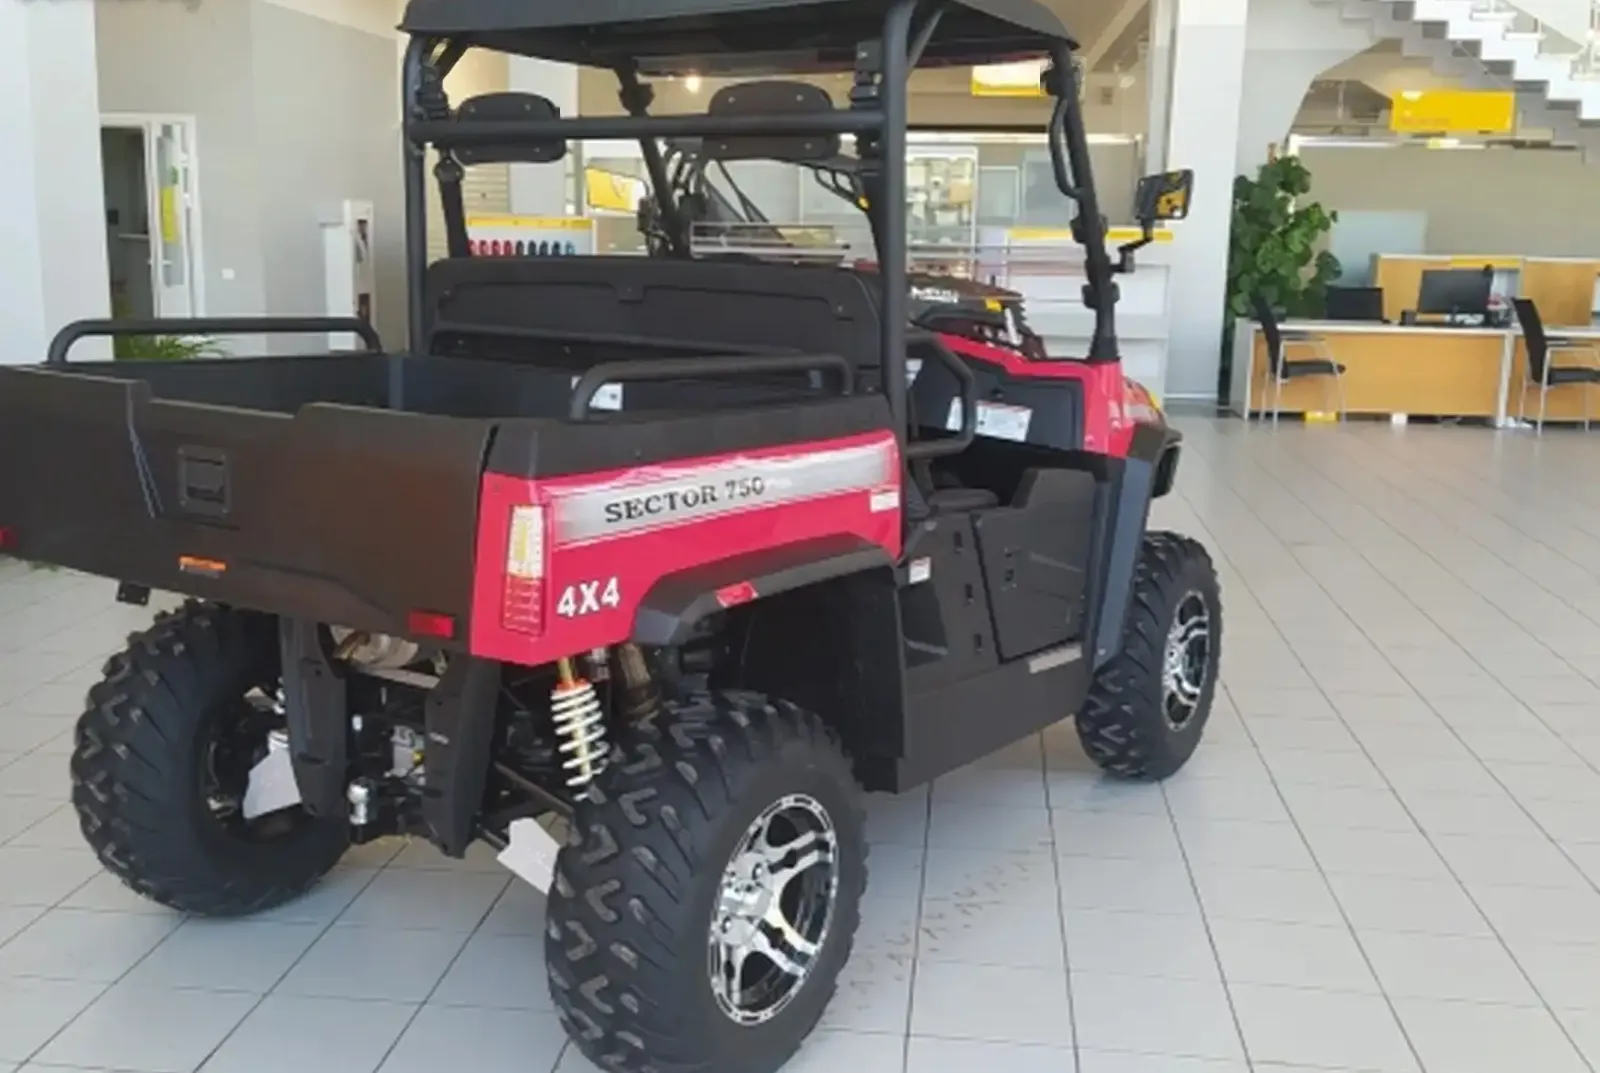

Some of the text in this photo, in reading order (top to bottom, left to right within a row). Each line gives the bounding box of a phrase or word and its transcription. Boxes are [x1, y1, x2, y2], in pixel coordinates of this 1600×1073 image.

[604, 475, 765, 523] SECTOR 750
[556, 575, 621, 617] 4X4
